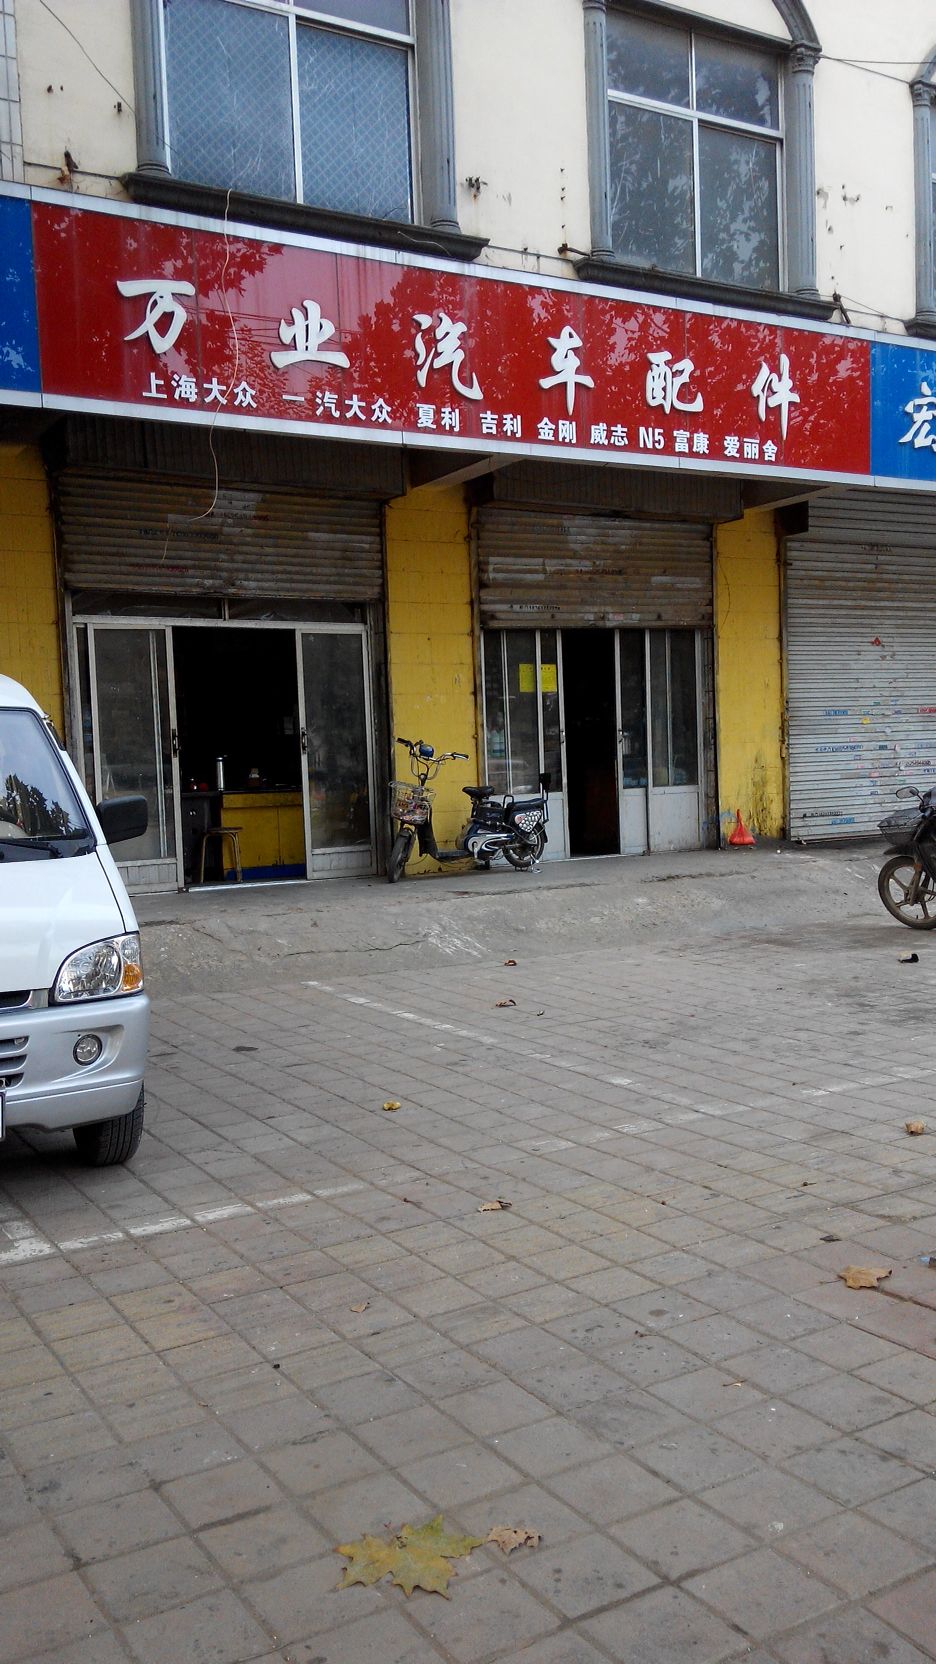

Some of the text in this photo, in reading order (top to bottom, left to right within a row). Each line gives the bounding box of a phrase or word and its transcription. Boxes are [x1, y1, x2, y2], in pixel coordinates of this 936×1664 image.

[116, 279, 801, 440] 万业汽车配件
[142, 373, 778, 462] 上海大众 一汽大众 夏利 吉利 金刚 威志 N5 富康 爱丽舍
